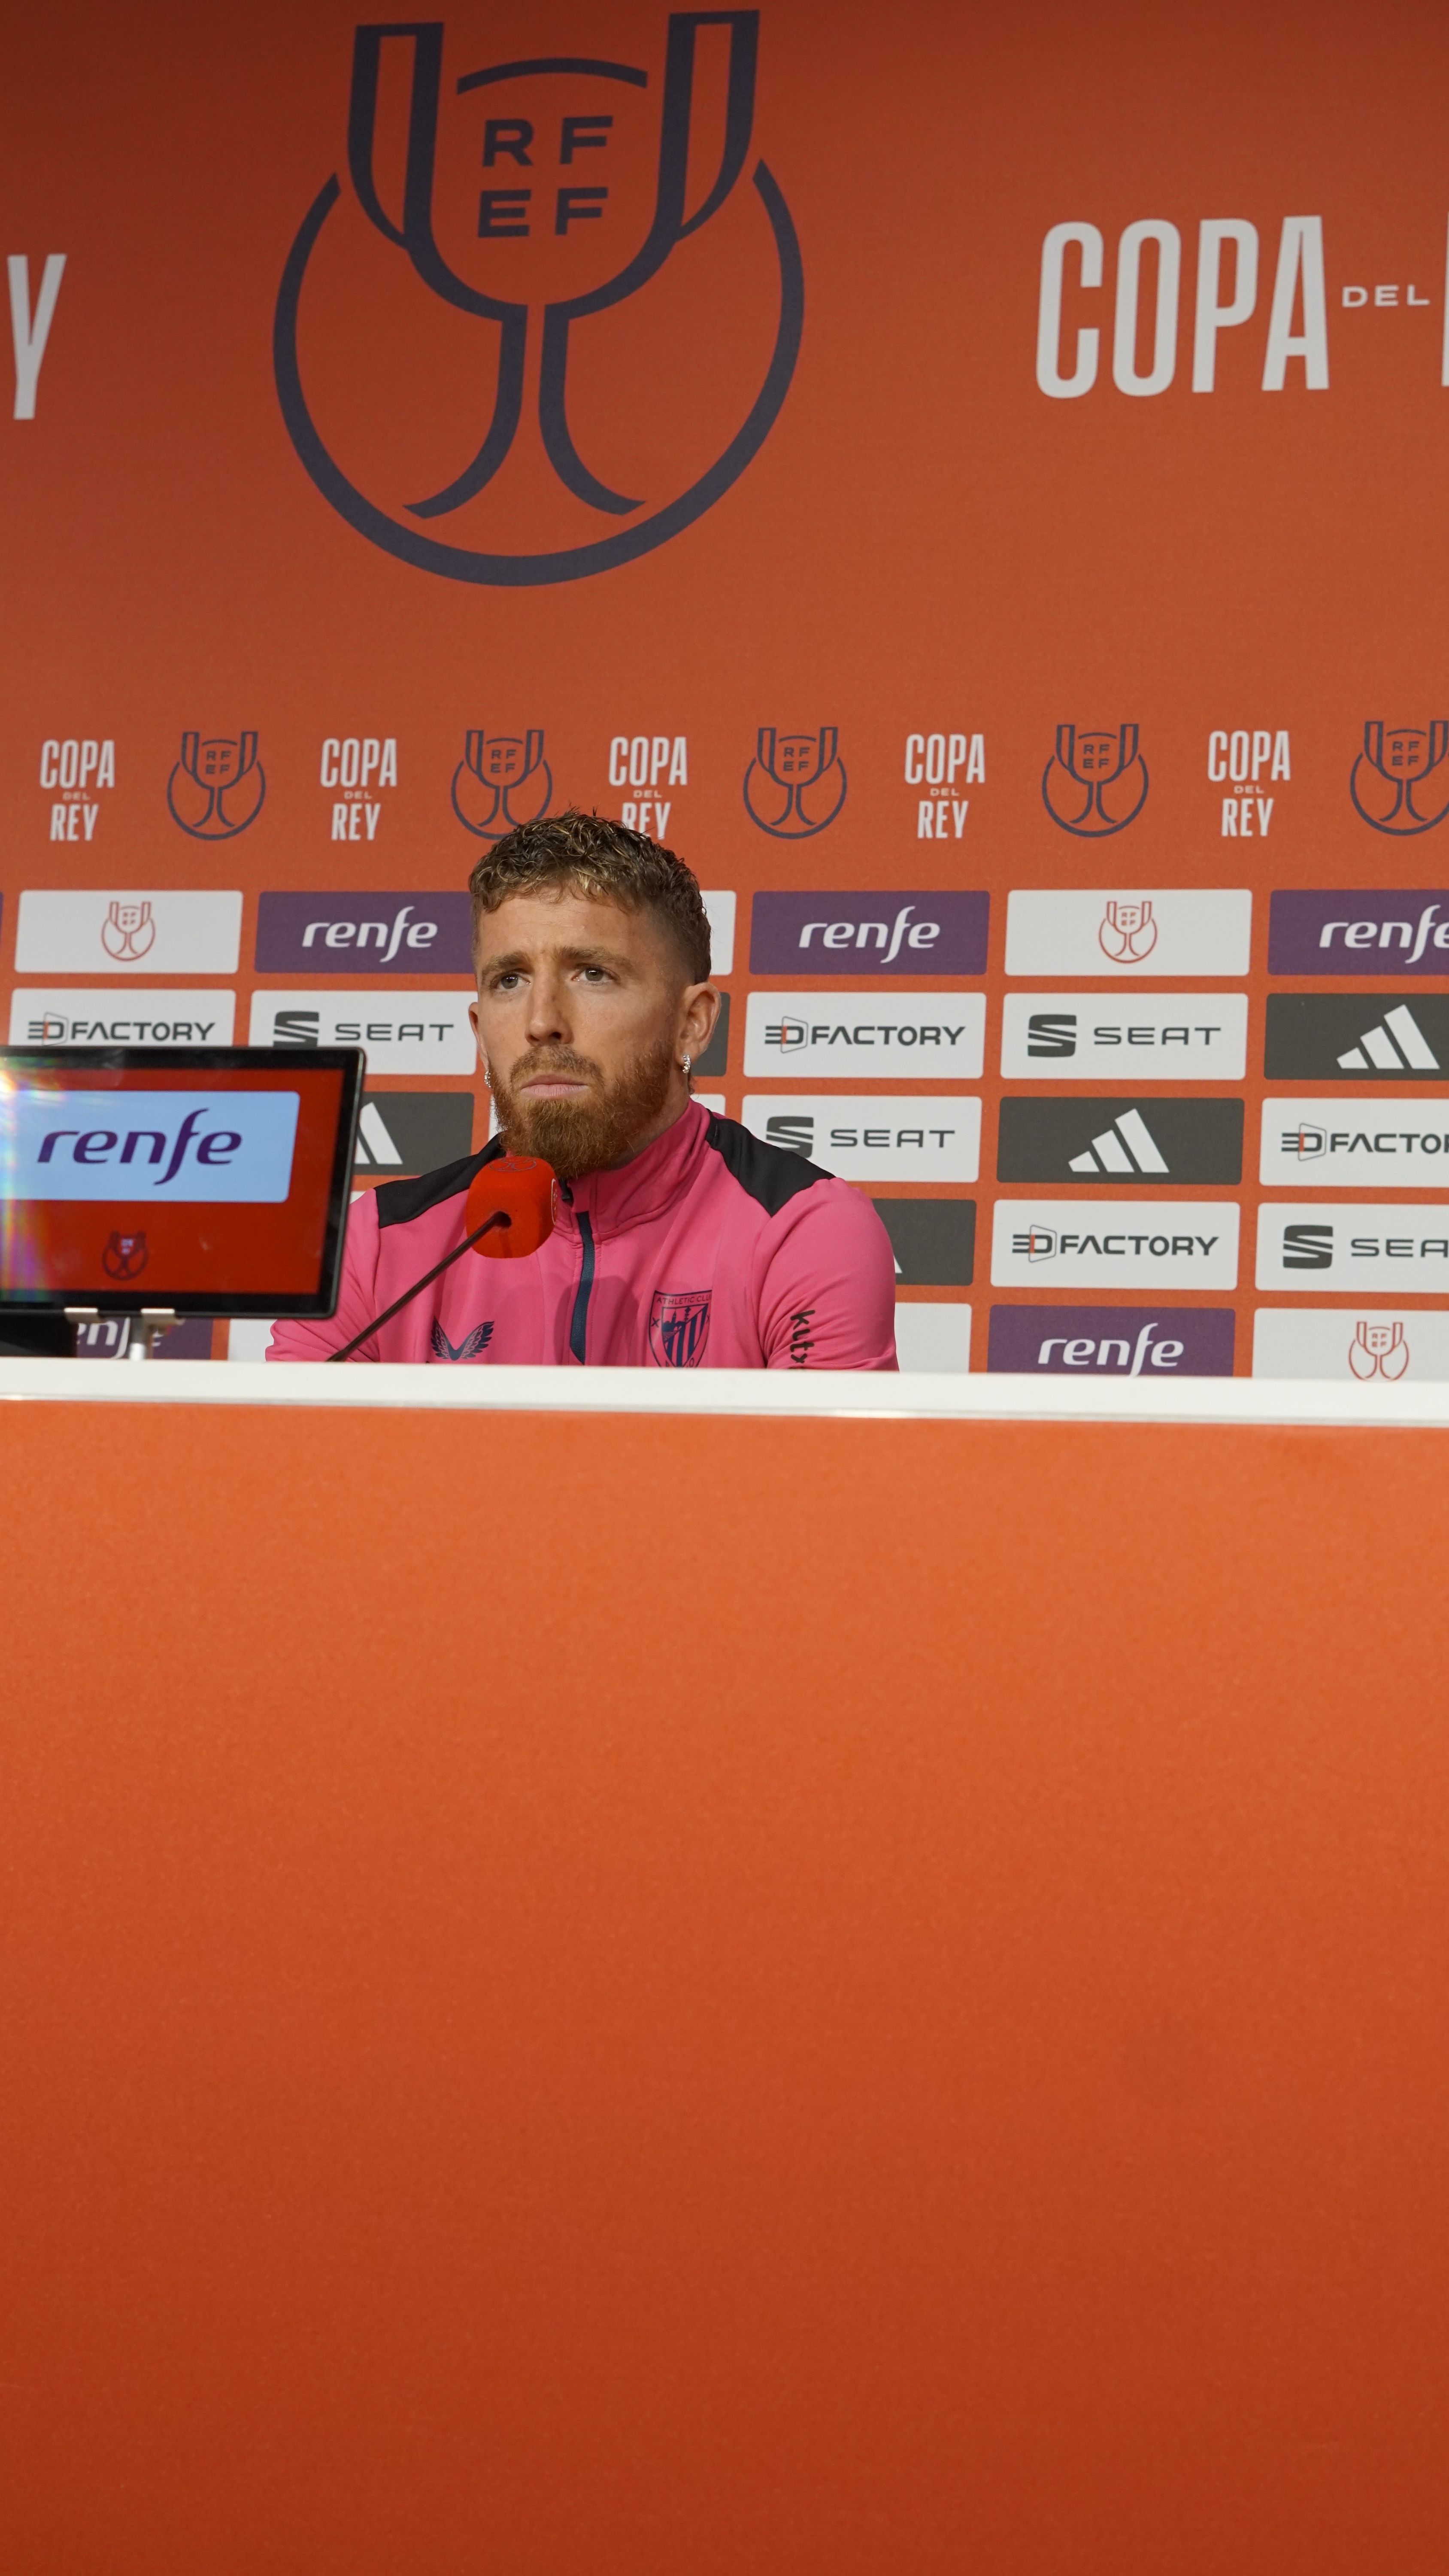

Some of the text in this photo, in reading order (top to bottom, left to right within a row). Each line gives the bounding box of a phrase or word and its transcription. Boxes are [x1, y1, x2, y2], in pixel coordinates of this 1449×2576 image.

[1036, 216, 1329, 398] COPA
[1343, 285, 1429, 307] DEL
[40, 740, 114, 788] COPA
[321, 738, 397, 787] COPA
[609, 737, 687, 786] COPA
[905, 734, 985, 784] COPA
[1208, 731, 1290, 781] COPA
[63, 792, 89, 800] DEL
[344, 791, 371, 799] DEL
[634, 790, 661, 798] DEL
[930, 788, 958, 796] DEL
[1234, 785, 1264, 794] DEL
[50, 804, 98, 841] REY
[332, 803, 380, 840] REY
[622, 802, 671, 840] REY
[918, 801, 968, 838] REY
[1222, 798, 1273, 836] REY
[303, 906, 437, 962] renfe
[799, 906, 940, 963] renfe
[335, 1024, 454, 1041] SEAT
[1094, 1027, 1221, 1045] SEAT
[38, 1109, 242, 1185] renfe
[831, 1129, 955, 1148] SEAT
[697, 1294, 712, 1302] CLU
[1038, 1323, 1183, 1377] renfe
